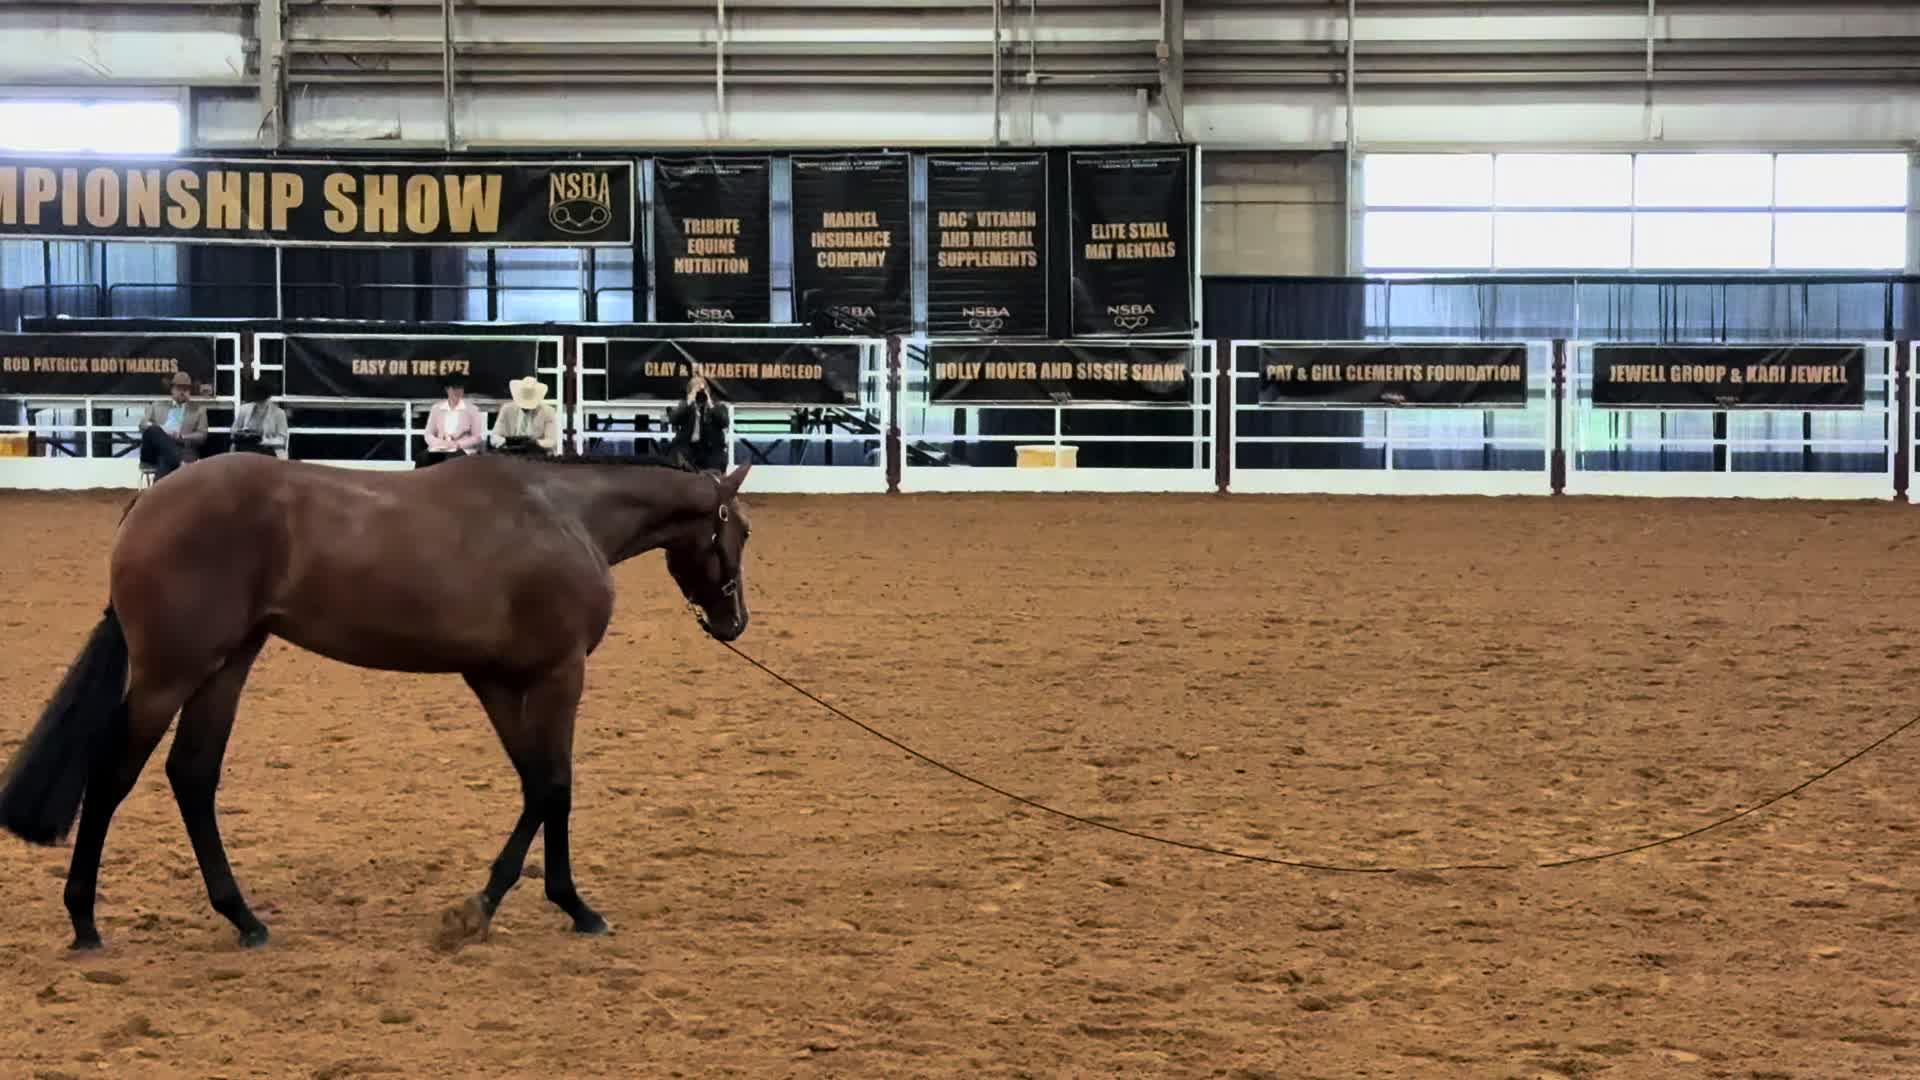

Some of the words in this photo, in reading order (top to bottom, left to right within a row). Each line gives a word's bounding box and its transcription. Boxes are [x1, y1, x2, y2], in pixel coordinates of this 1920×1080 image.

[549, 172, 611, 207] NSBA
[323, 172, 502, 234] SHOW
[683, 218, 741, 234] TRIBUTE
[823, 212, 879, 228] MARKEL
[976, 211, 1037, 228] VITAMIN
[941, 231, 970, 248] AND
[973, 231, 1034, 248] MINERAL
[1091, 223, 1126, 240] ELITE
[1129, 222, 1169, 239] STALL
[688, 238, 736, 255] EQUINE
[811, 231, 892, 249] INSURANCE
[1085, 243, 1114, 260] MAT
[1116, 241, 1176, 259] RENTALS
[674, 258, 749, 274] NUTRITION
[817, 251, 886, 268] COMPANY
[937, 251, 1037, 268] SUPPLEMENTS
[687, 308, 735, 320] NSBA
[962, 307, 1010, 318] NSBA
[1107, 304, 1155, 316] NSBA
[33, 357, 88, 373] PATRICK
[91, 358, 178, 373] BOOTMAKERS
[352, 359, 387, 375] EASY
[389, 359, 408, 375] ON
[411, 359, 437, 375] THE
[644, 361, 676, 377] CLAY
[679, 365, 688, 377] &
[761, 363, 823, 380] MACLEOD
[935, 362, 980, 380] HOLLY
[985, 362, 1037, 380] HOVER
[1040, 362, 1073, 379] AND
[1076, 363, 1129, 380] SISSIE
[1266, 364, 1294, 381] PAT
[1297, 367, 1307, 381] &
[1311, 364, 1342, 381] GILL
[1346, 364, 1423, 381] CLEMENTS
[1426, 364, 1521, 382] FOUNDATION
[1610, 364, 1666, 383] JEWELL
[1670, 365, 1726, 383] GROUP
[1730, 369, 1742, 383] &
[1746, 364, 1786, 383] KARI
[1790, 364, 1848, 383] JEWELL
